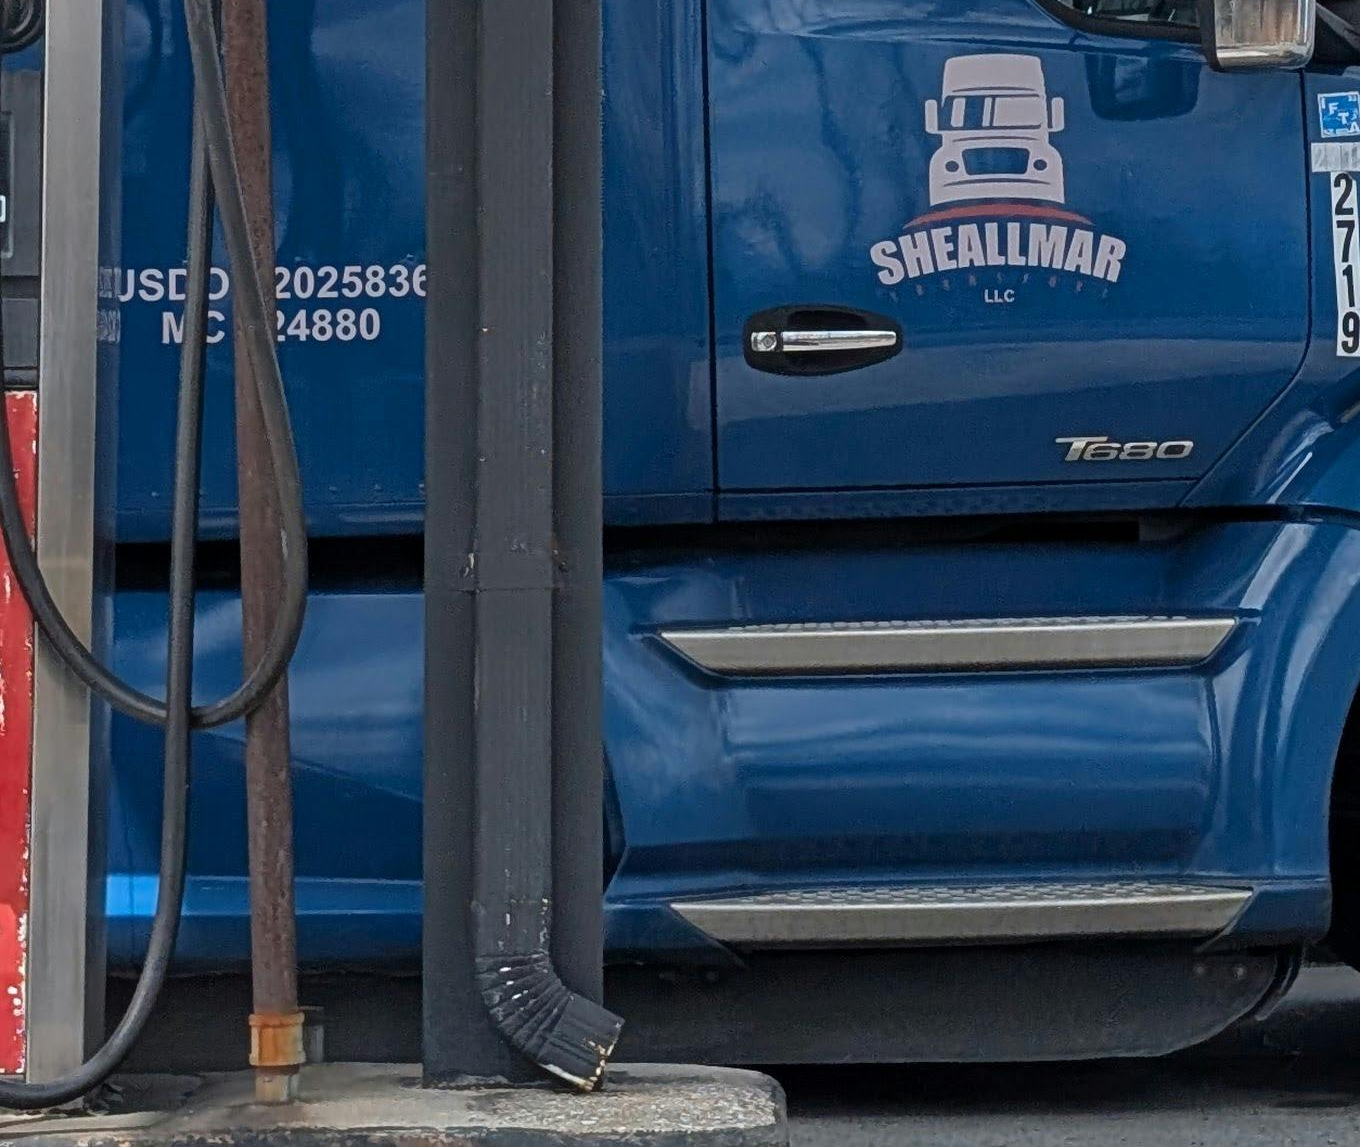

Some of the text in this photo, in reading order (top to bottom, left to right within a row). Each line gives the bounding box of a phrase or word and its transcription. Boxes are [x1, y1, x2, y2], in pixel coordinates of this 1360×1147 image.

[869, 221, 1127, 286] SHEALLMAR
[984, 288, 1016, 303] LLC
[1055, 436, 1194, 461] T680
